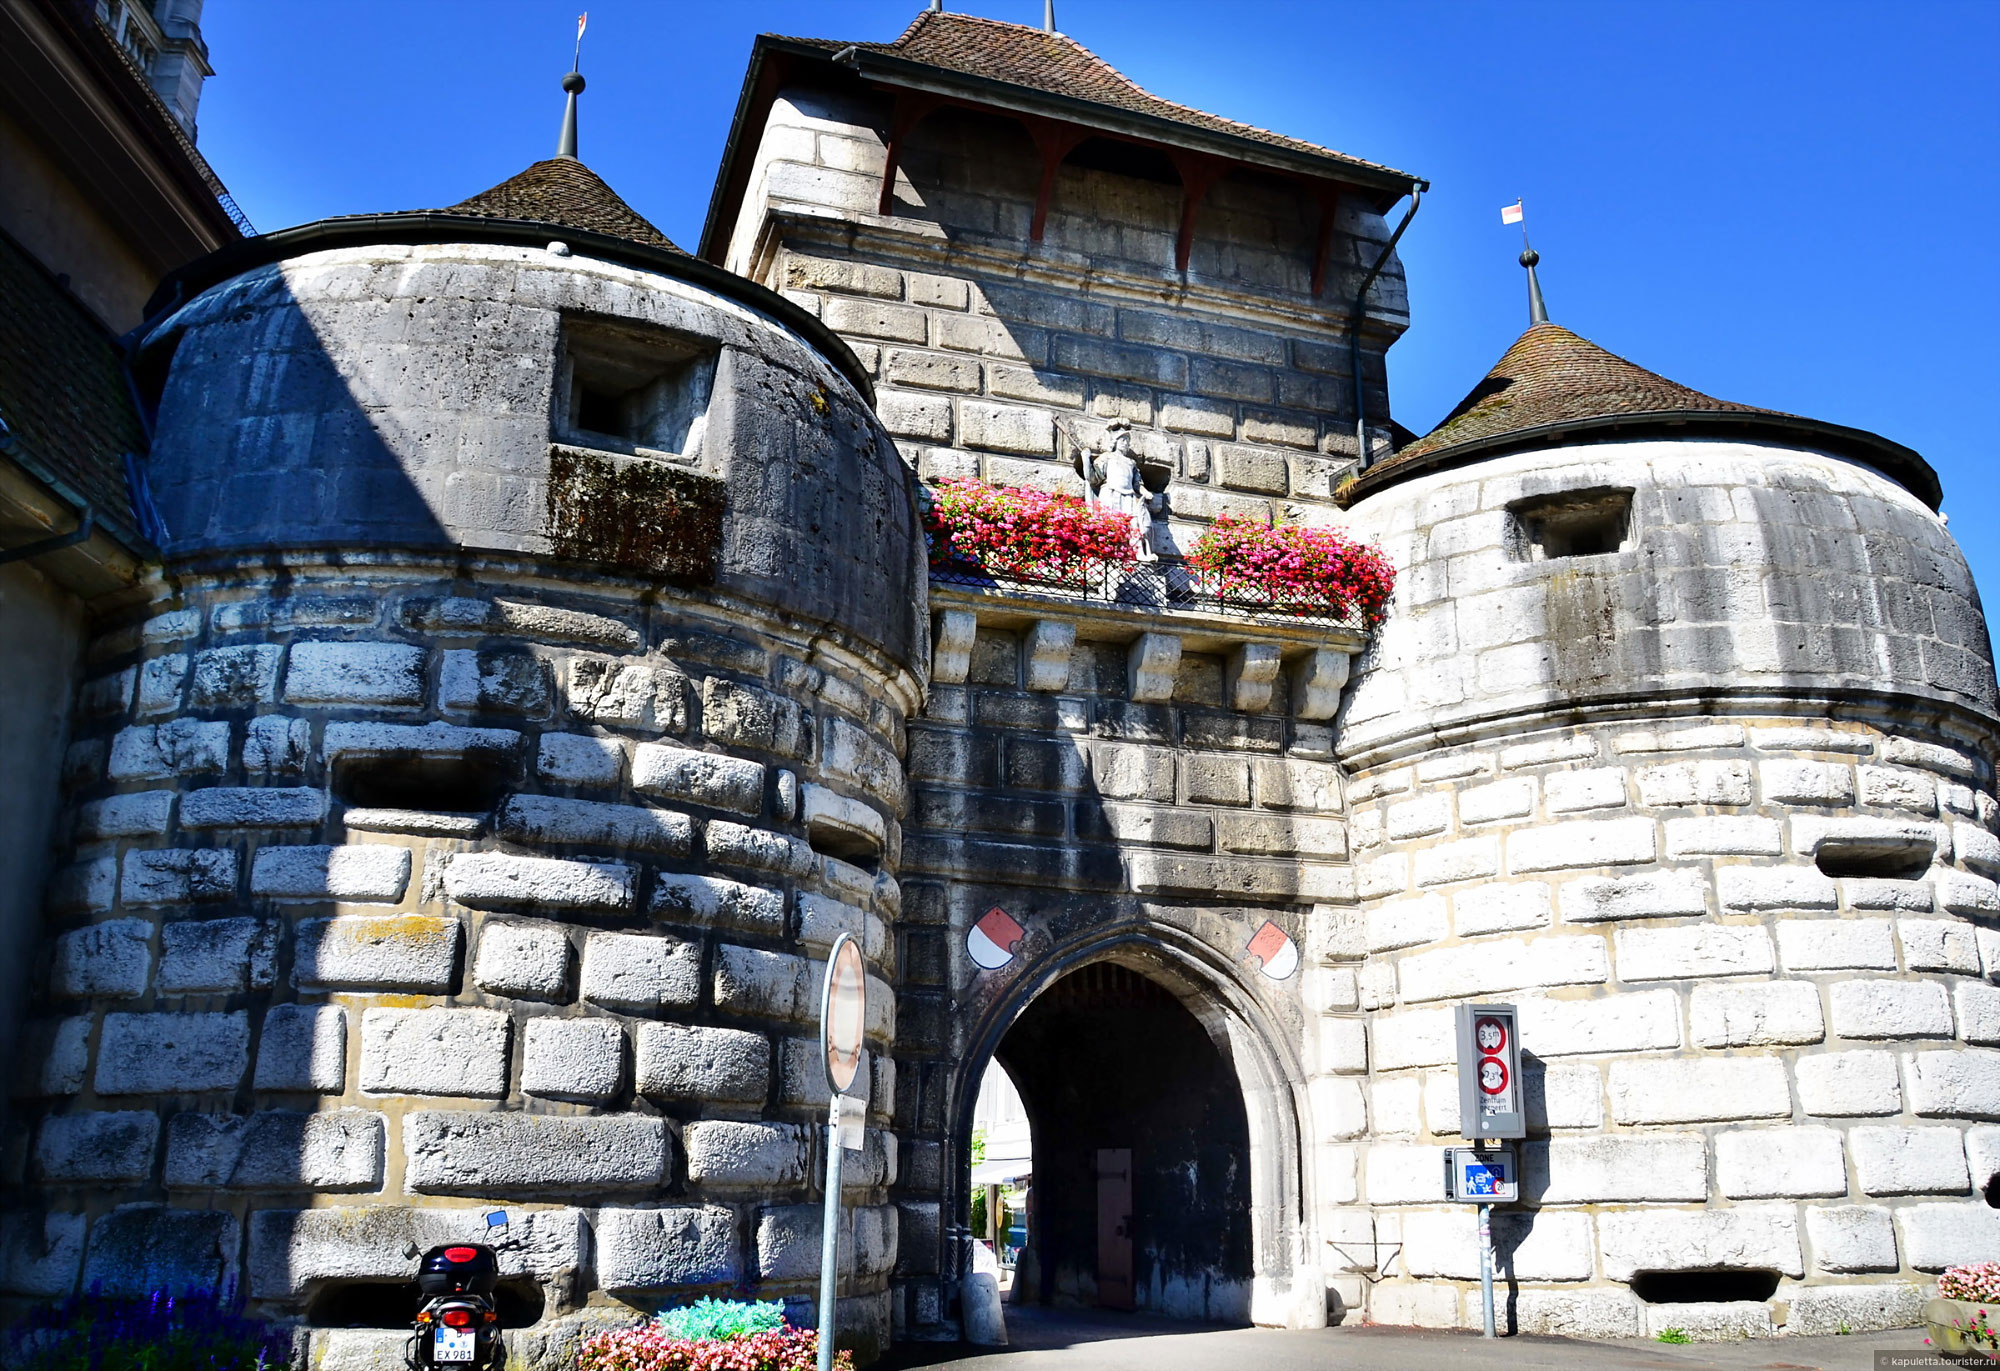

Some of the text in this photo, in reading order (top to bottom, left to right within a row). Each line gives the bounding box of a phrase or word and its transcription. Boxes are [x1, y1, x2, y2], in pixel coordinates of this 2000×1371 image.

[1480, 1096, 1506, 1104] Zentrum
[1475, 1154, 1494, 1162] ZONE
[437, 1350, 472, 1359] EX 981
